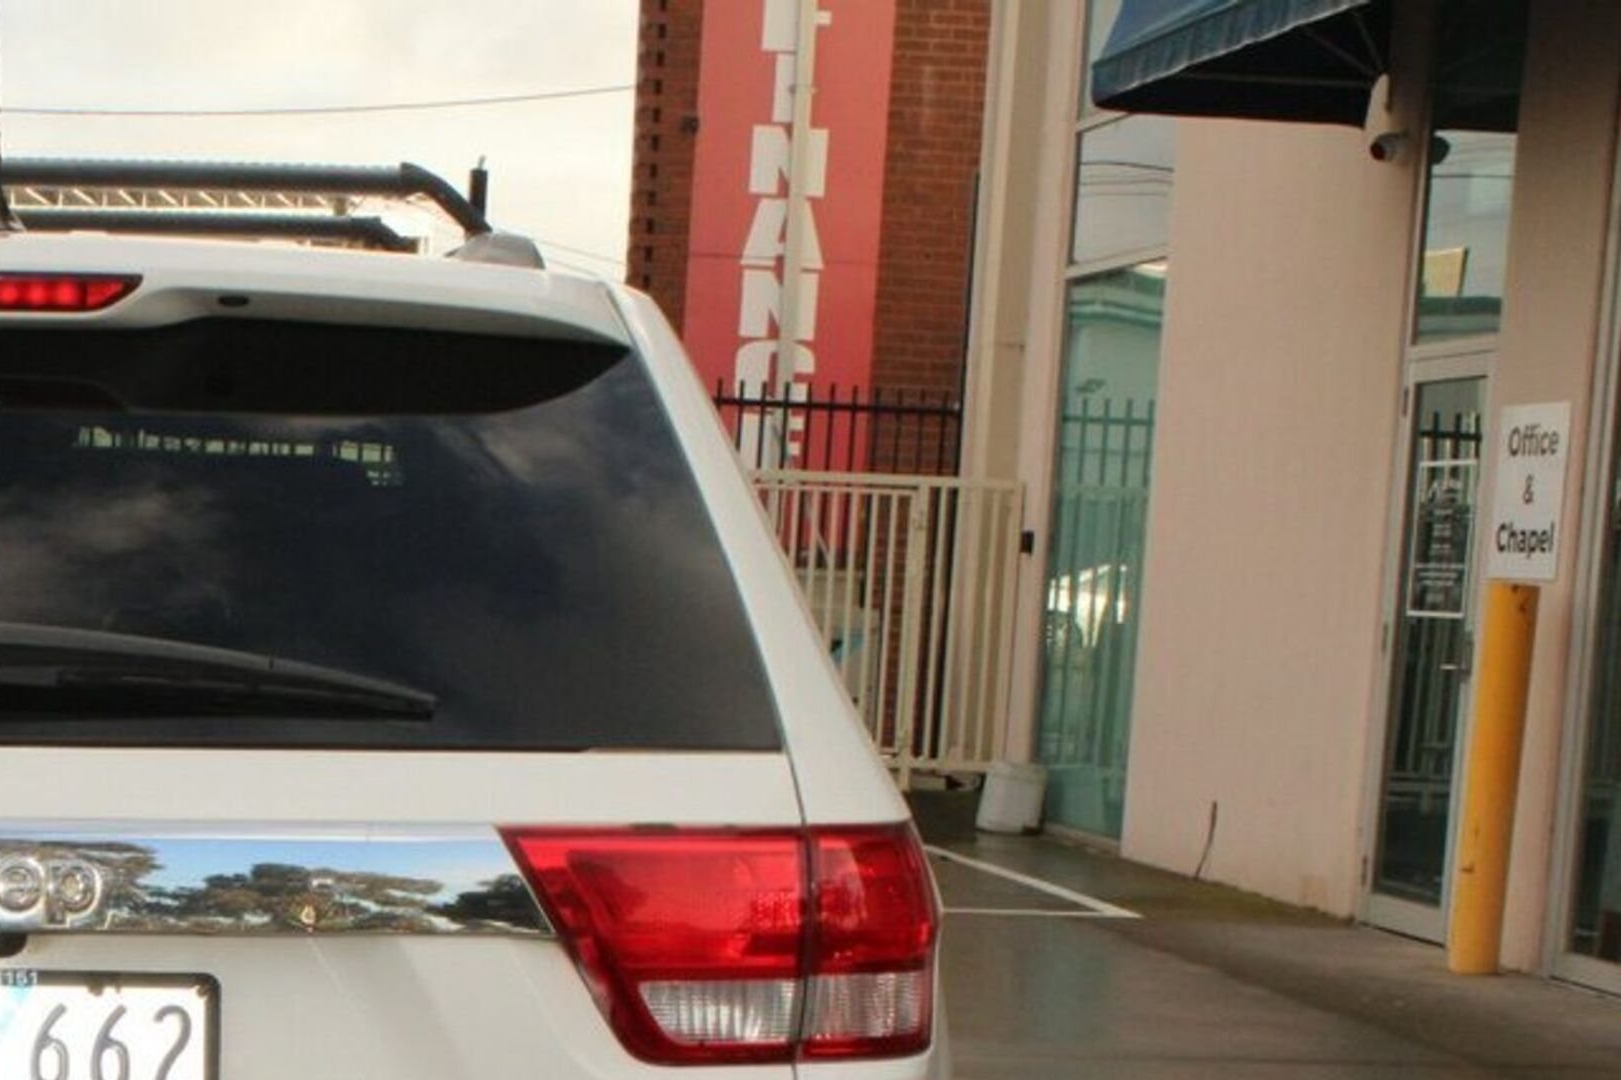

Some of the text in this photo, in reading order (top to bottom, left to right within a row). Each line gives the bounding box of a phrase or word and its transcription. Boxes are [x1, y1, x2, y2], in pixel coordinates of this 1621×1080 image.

[1508, 423, 1560, 457] Office
[1522, 472, 1535, 505] &
[1496, 520, 1556, 560] Chapel
